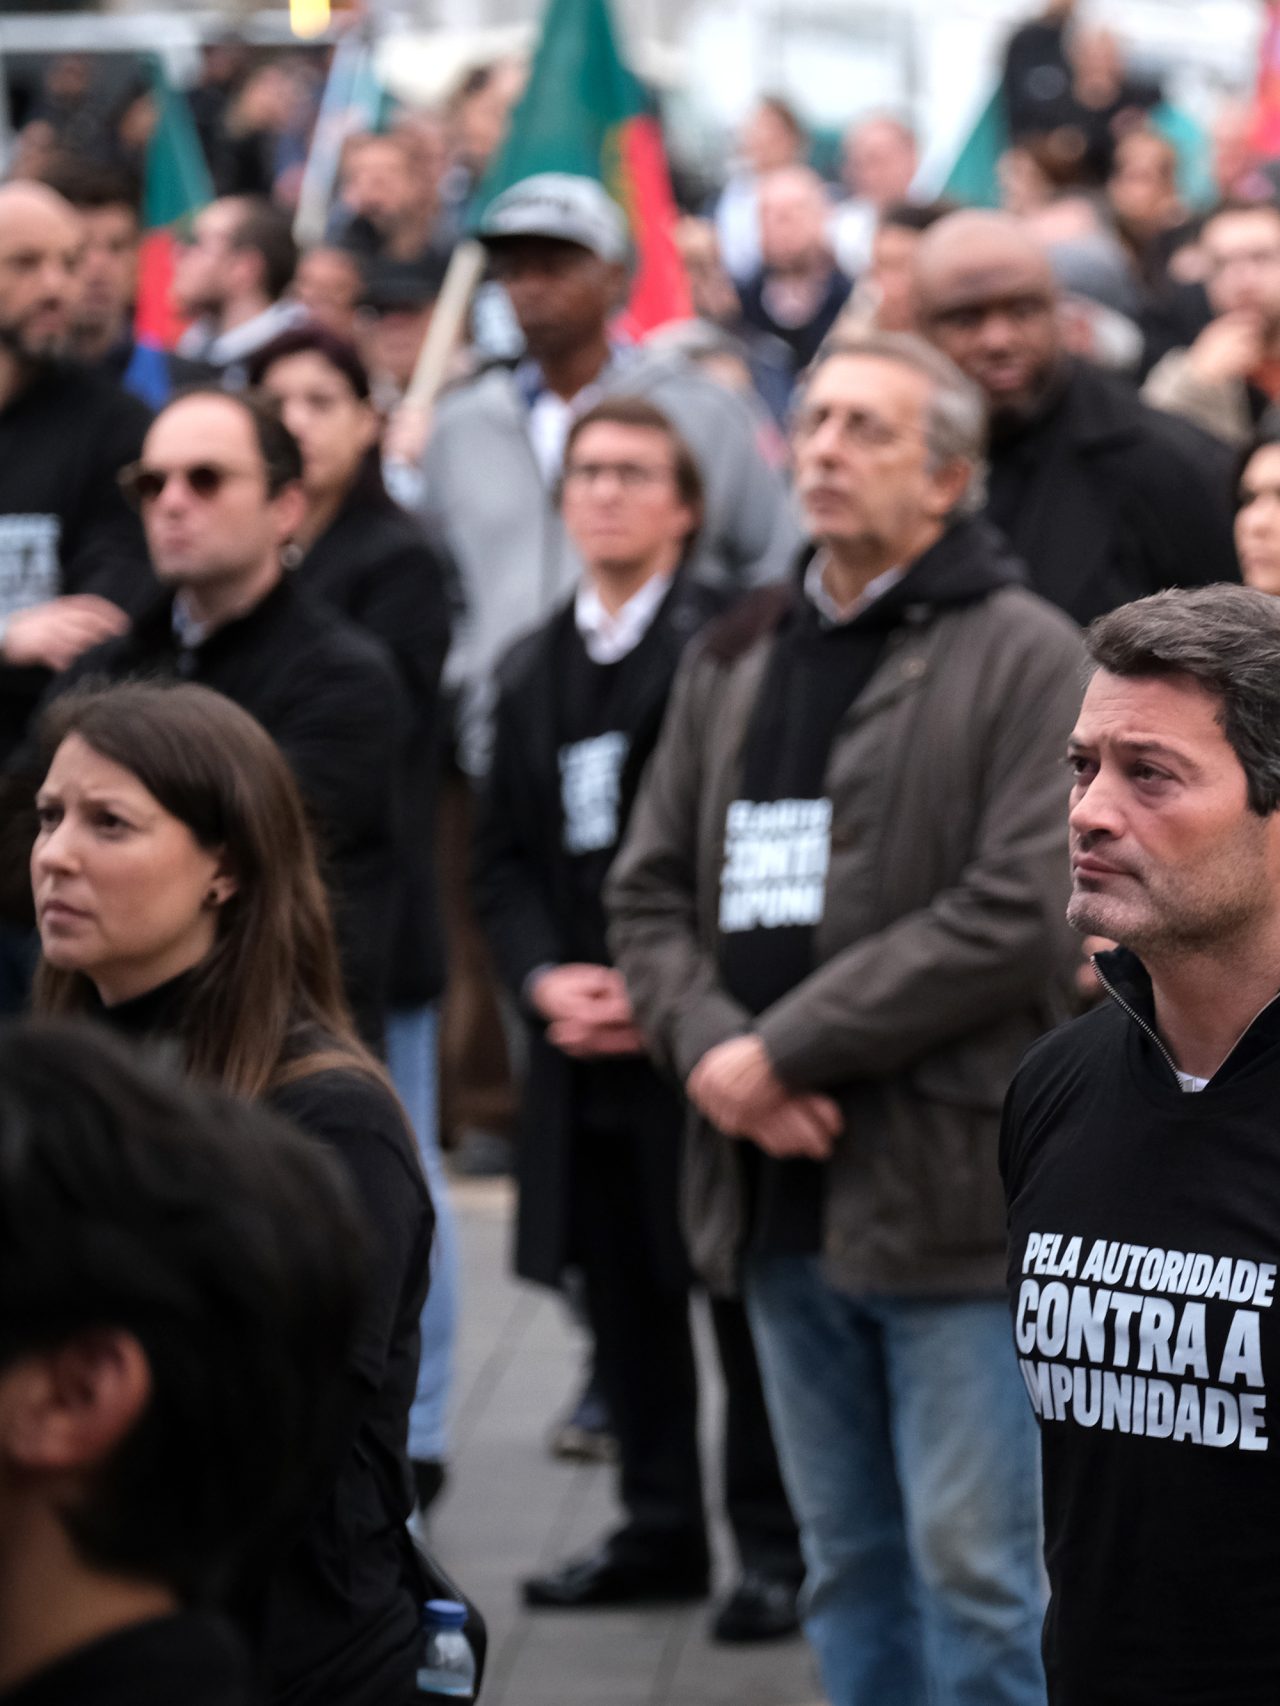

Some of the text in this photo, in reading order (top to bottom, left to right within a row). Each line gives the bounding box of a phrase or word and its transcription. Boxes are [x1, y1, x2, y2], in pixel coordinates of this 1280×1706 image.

[1021, 1231, 1278, 1308] PELA AUTORIDADE
[1015, 1278, 1266, 1389] CONTRA A
